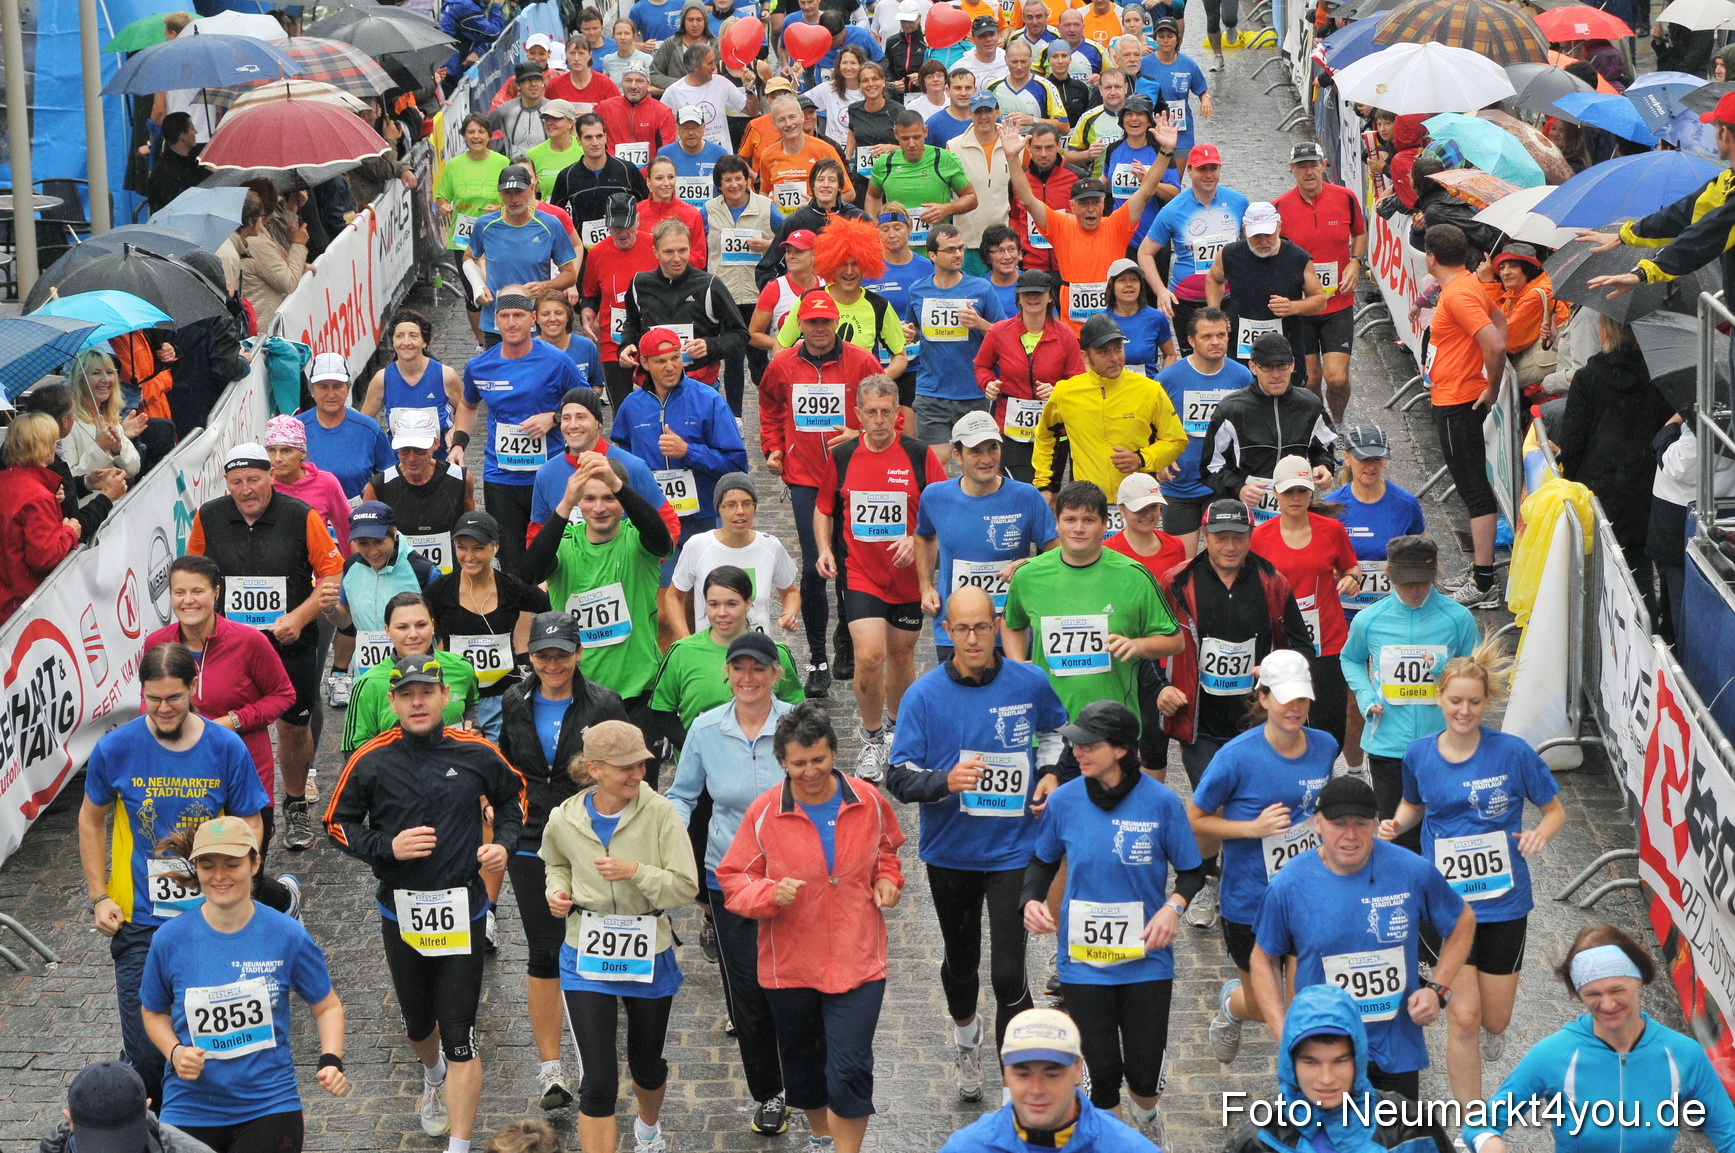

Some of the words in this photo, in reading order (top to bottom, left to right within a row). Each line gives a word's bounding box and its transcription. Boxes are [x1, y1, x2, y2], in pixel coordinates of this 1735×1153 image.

[679, 185, 709, 199] 2694
[778, 192, 800, 206] 573
[812, 299, 828, 309] Z
[1073, 293, 1106, 309] 3058
[931, 310, 959, 326] 515
[935, 328, 955, 336] Stefan
[798, 396, 840, 414] 2992
[806, 418, 831, 426] Helmut
[500, 434, 542, 455] 2429
[506, 456, 535, 465] Manfred
[353, 513, 378, 521] QUELLE.
[856, 504, 901, 524] 2748
[868, 527, 889, 535] Frank
[231, 591, 281, 611] 3008
[245, 615, 266, 623] Hans
[571, 600, 621, 629] 2767
[586, 628, 613, 640] Volker
[1049, 631, 1103, 654] 2775
[361, 646, 394, 667] 304
[1062, 656, 1092, 667] Konrad
[59, 659, 66, 680] &
[1205, 652, 1252, 676] 2637
[1394, 661, 1434, 683] 402
[1213, 679, 1239, 688] Alfons
[92, 679, 122, 720] SEAT
[1400, 688, 1427, 697] Gisela
[131, 777, 146, 787] 10.
[148, 777, 221, 789] NEUMARKTER
[979, 768, 1022, 792] 839
[145, 787, 208, 798] STADTLAUF
[977, 797, 1006, 807] Arnold
[1443, 850, 1504, 880] 2905
[1463, 882, 1487, 892] Julia
[1371, 899, 1404, 908] STADTLAUF
[411, 907, 454, 931] 546
[1084, 920, 1129, 945] 547
[419, 936, 447, 947] Alfred
[586, 930, 648, 957] 2976
[1086, 948, 1127, 960] Katarina
[602, 961, 628, 972] Doris
[1335, 967, 1400, 997] 2958
[1358, 1001, 1391, 1013] homas
[195, 999, 264, 1034] 2853
[212, 1033, 253, 1050] Daniela
